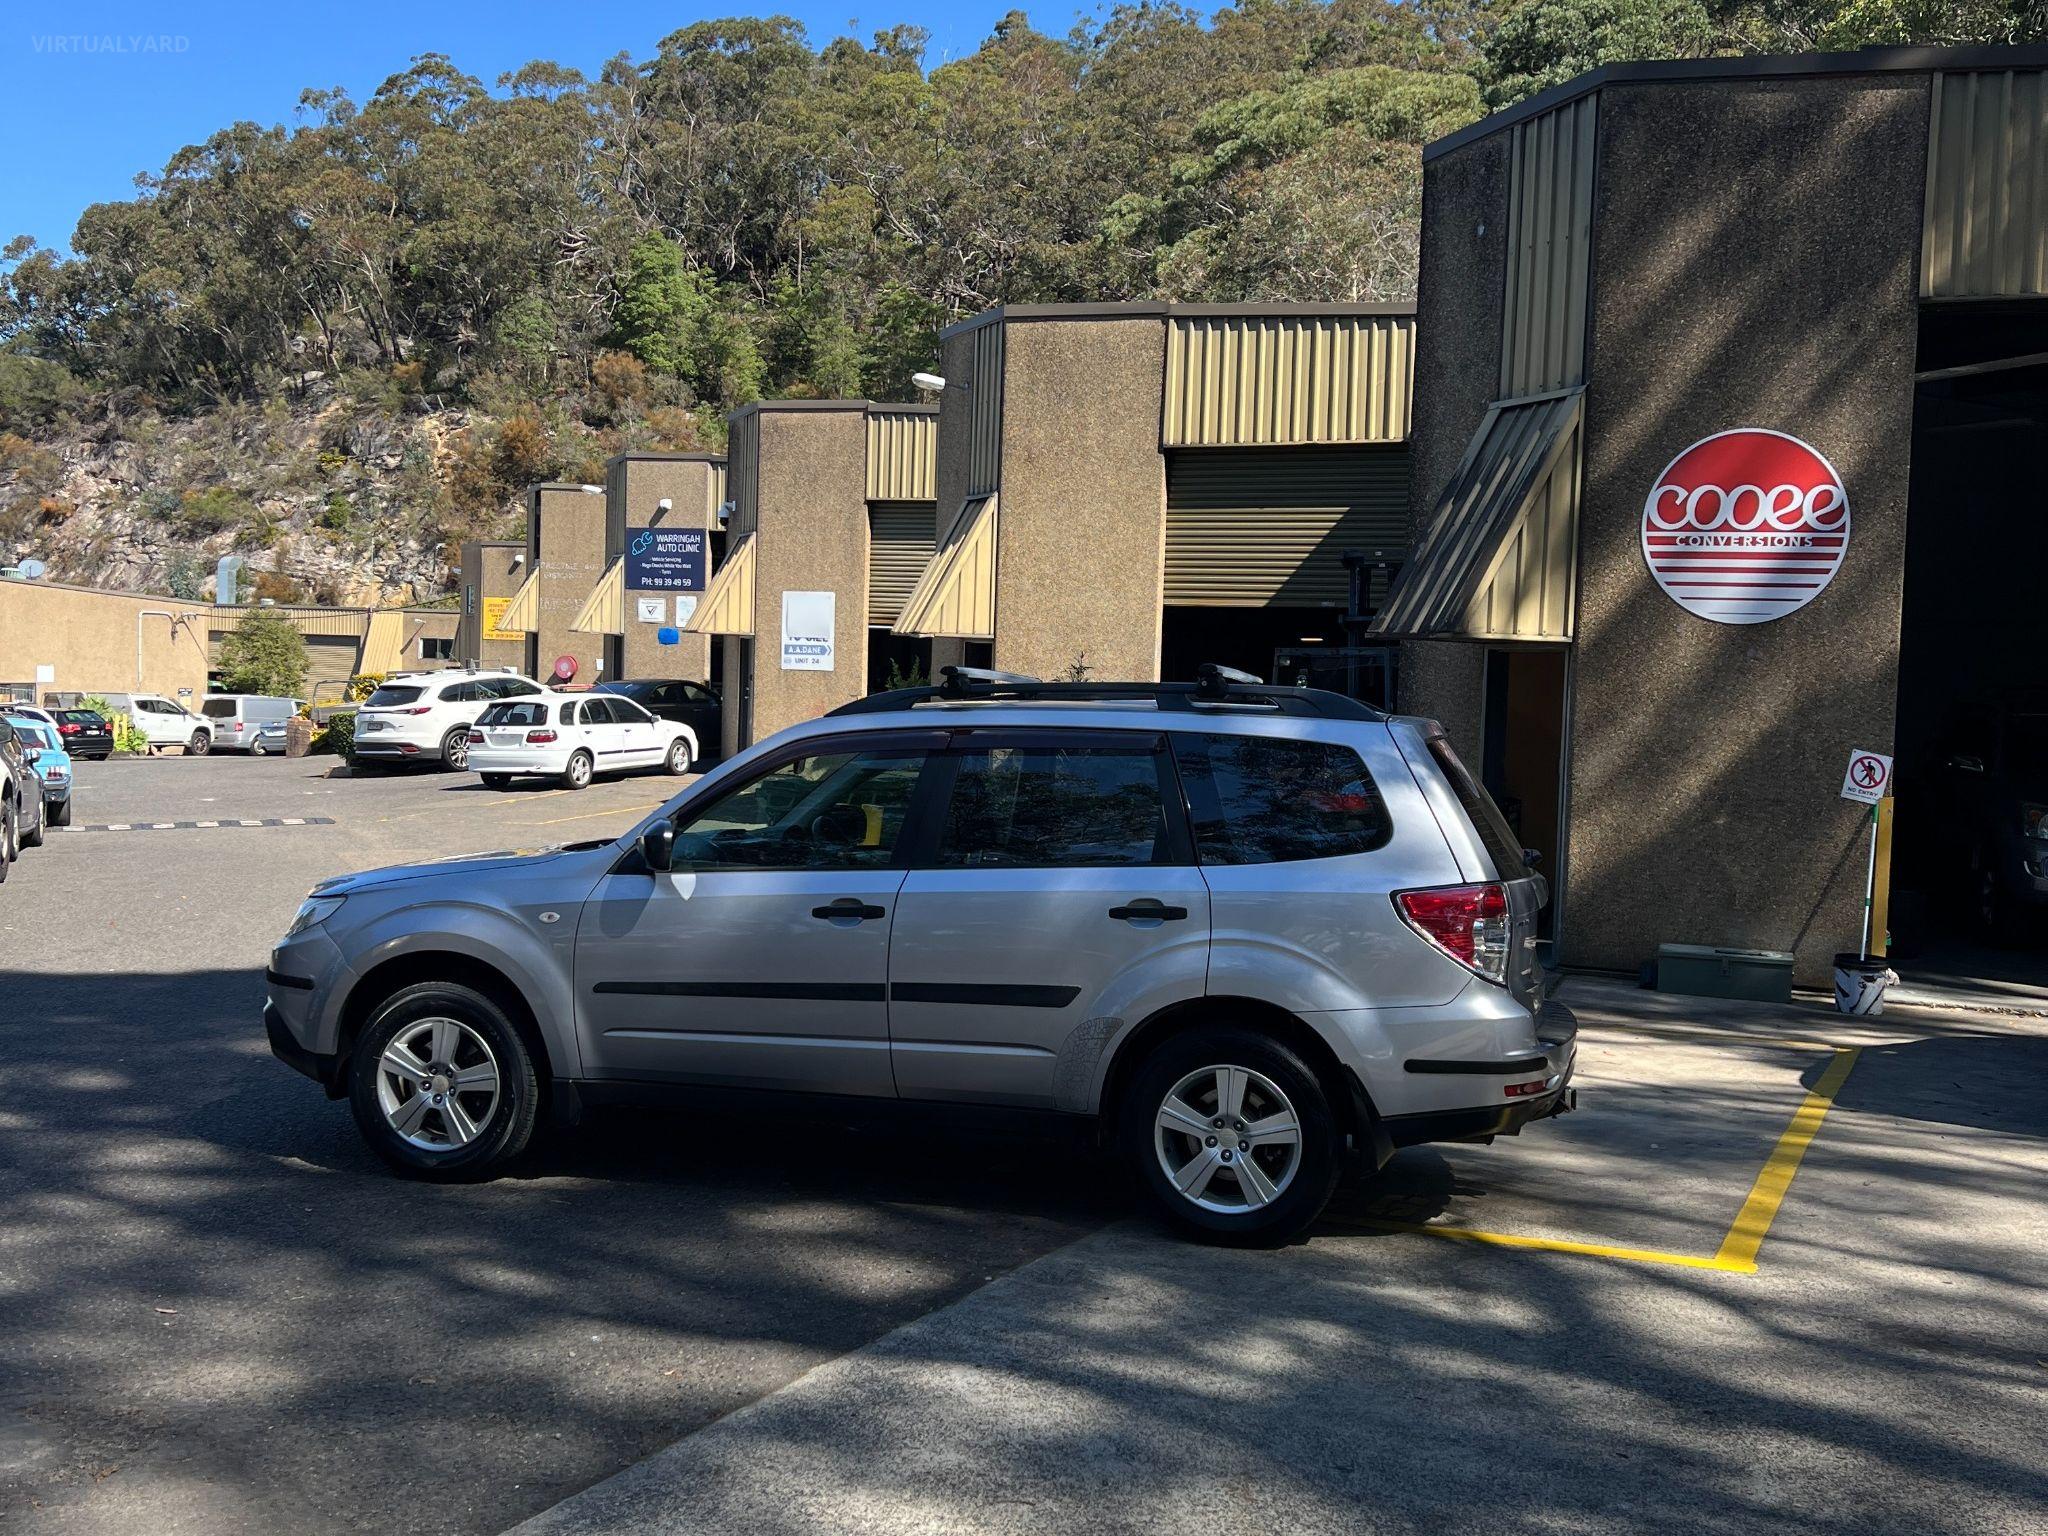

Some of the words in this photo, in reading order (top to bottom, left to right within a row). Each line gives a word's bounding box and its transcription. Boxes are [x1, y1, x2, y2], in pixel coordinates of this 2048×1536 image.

[1648, 484, 1847, 531] cooee
[656, 534, 701, 543] WARRINGAH
[1675, 535, 1813, 548] CONVERSIONS
[657, 544, 677, 552] AUTO
[678, 544, 700, 552] CLINIC
[654, 578, 662, 586] 99
[664, 578, 672, 586] 39
[682, 578, 691, 586] 59
